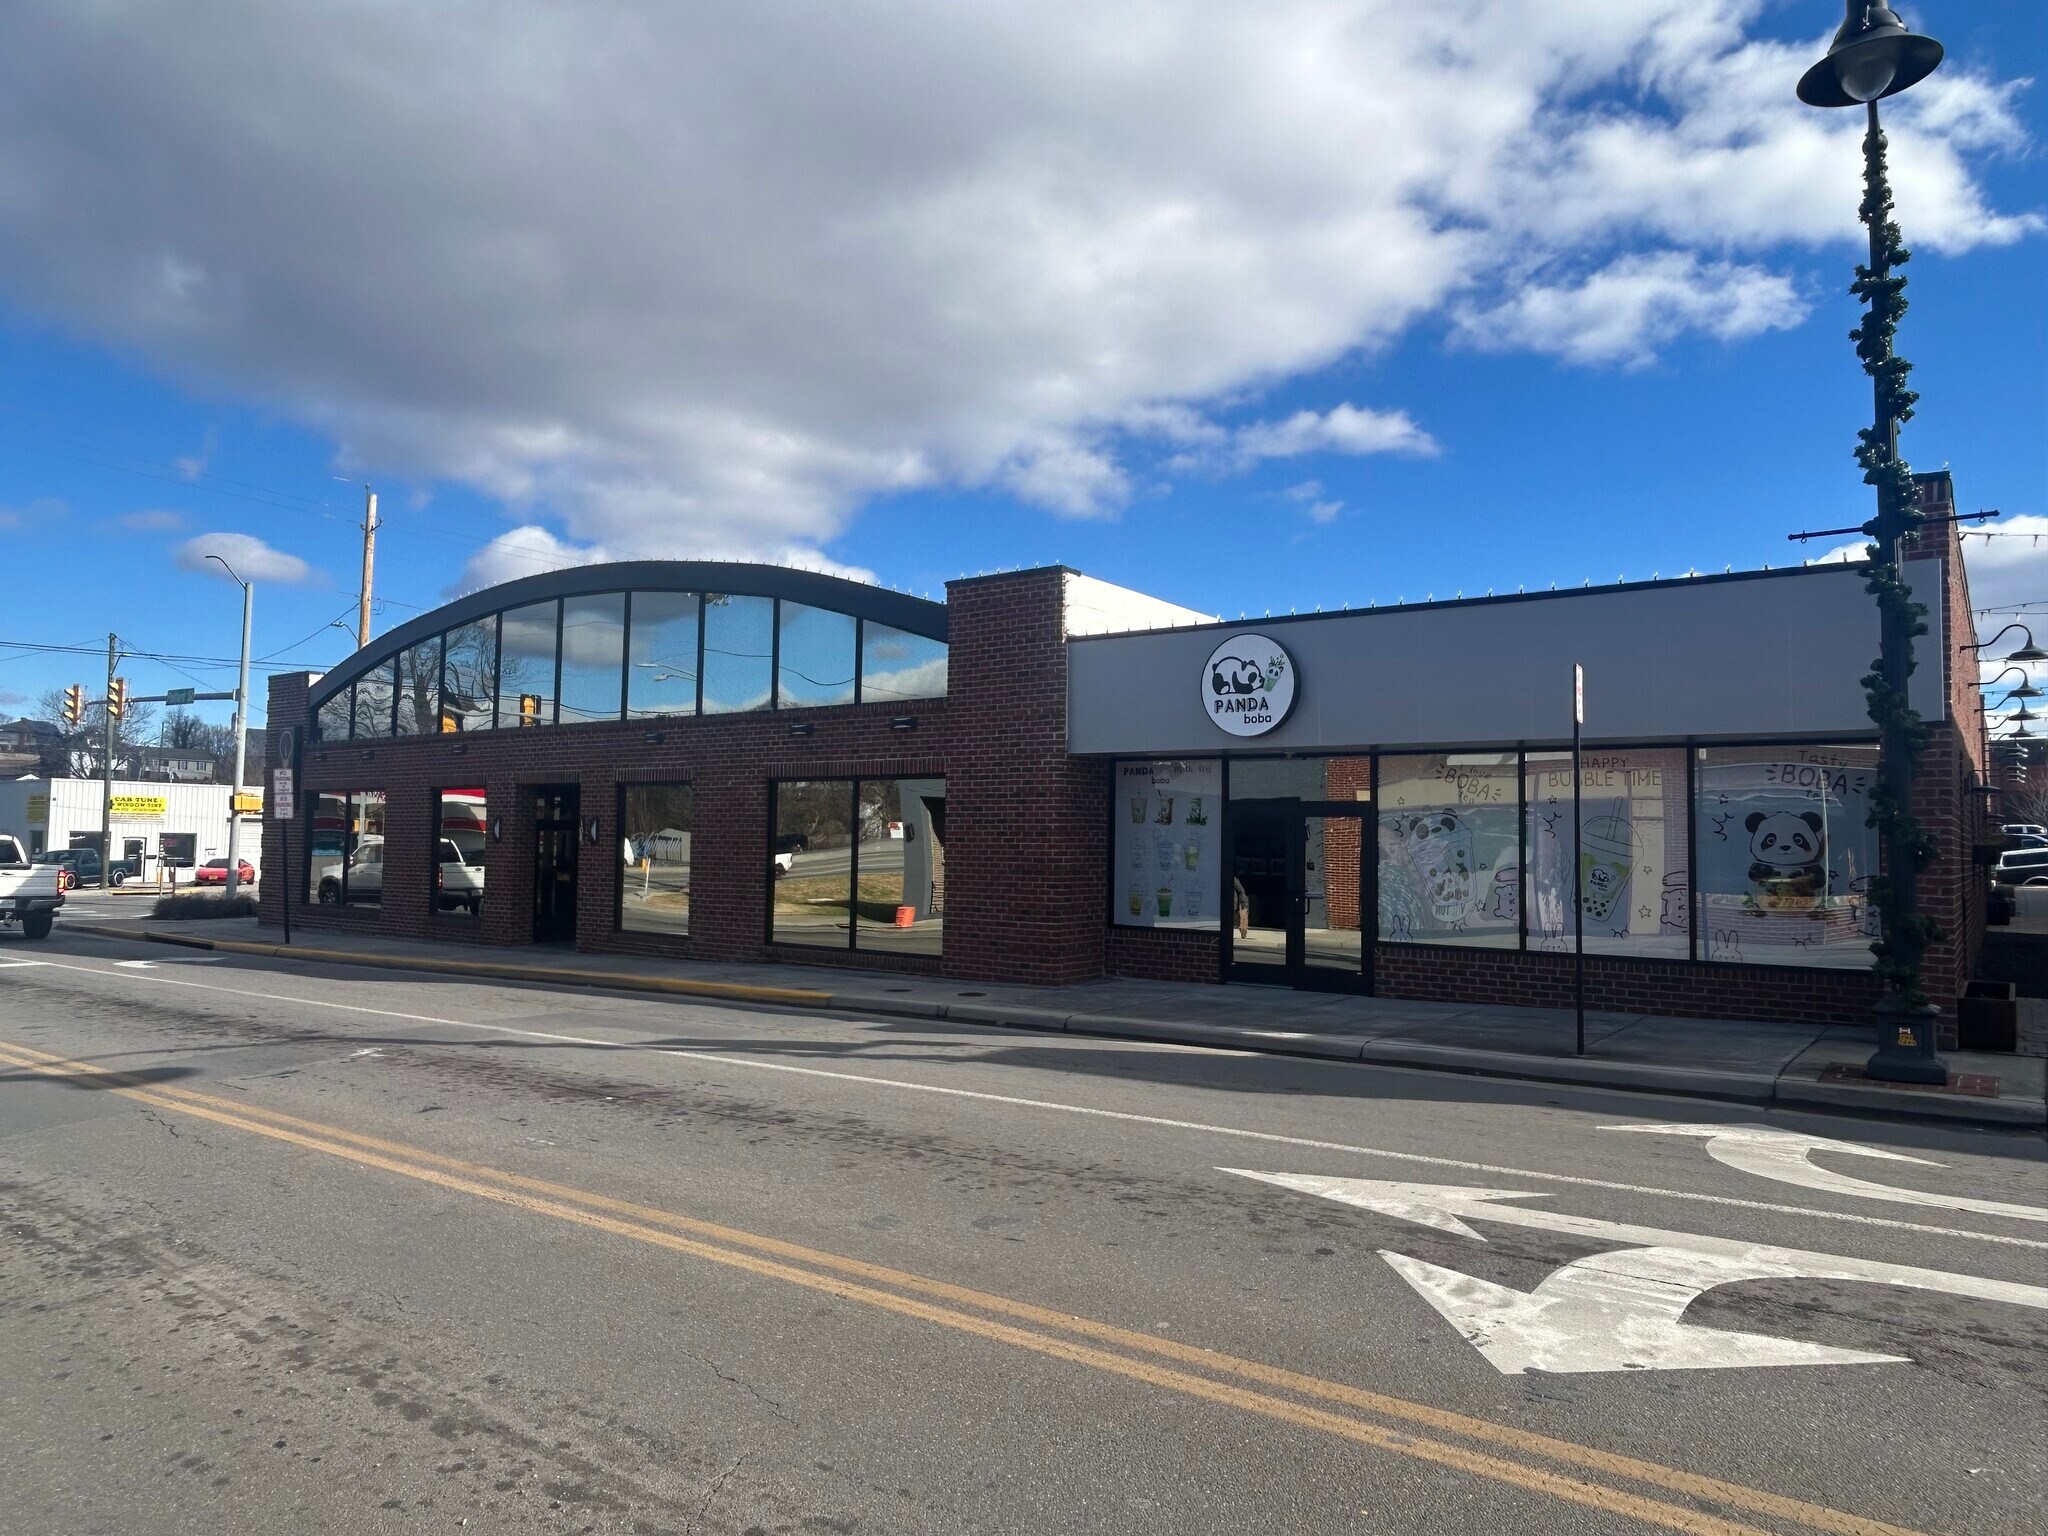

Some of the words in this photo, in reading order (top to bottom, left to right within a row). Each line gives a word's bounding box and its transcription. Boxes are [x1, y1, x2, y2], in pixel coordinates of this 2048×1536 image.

[1213, 696, 1269, 714] PANDA
[1243, 713, 1272, 724] boba
[1580, 757, 1629, 769] HAPPY
[1123, 766, 1154, 776] PANDA
[1151, 776, 1170, 784] boba
[1444, 767, 1490, 800] BOBA
[1548, 770, 1614, 787] BUBLE
[1781, 763, 1847, 795] BOBA
